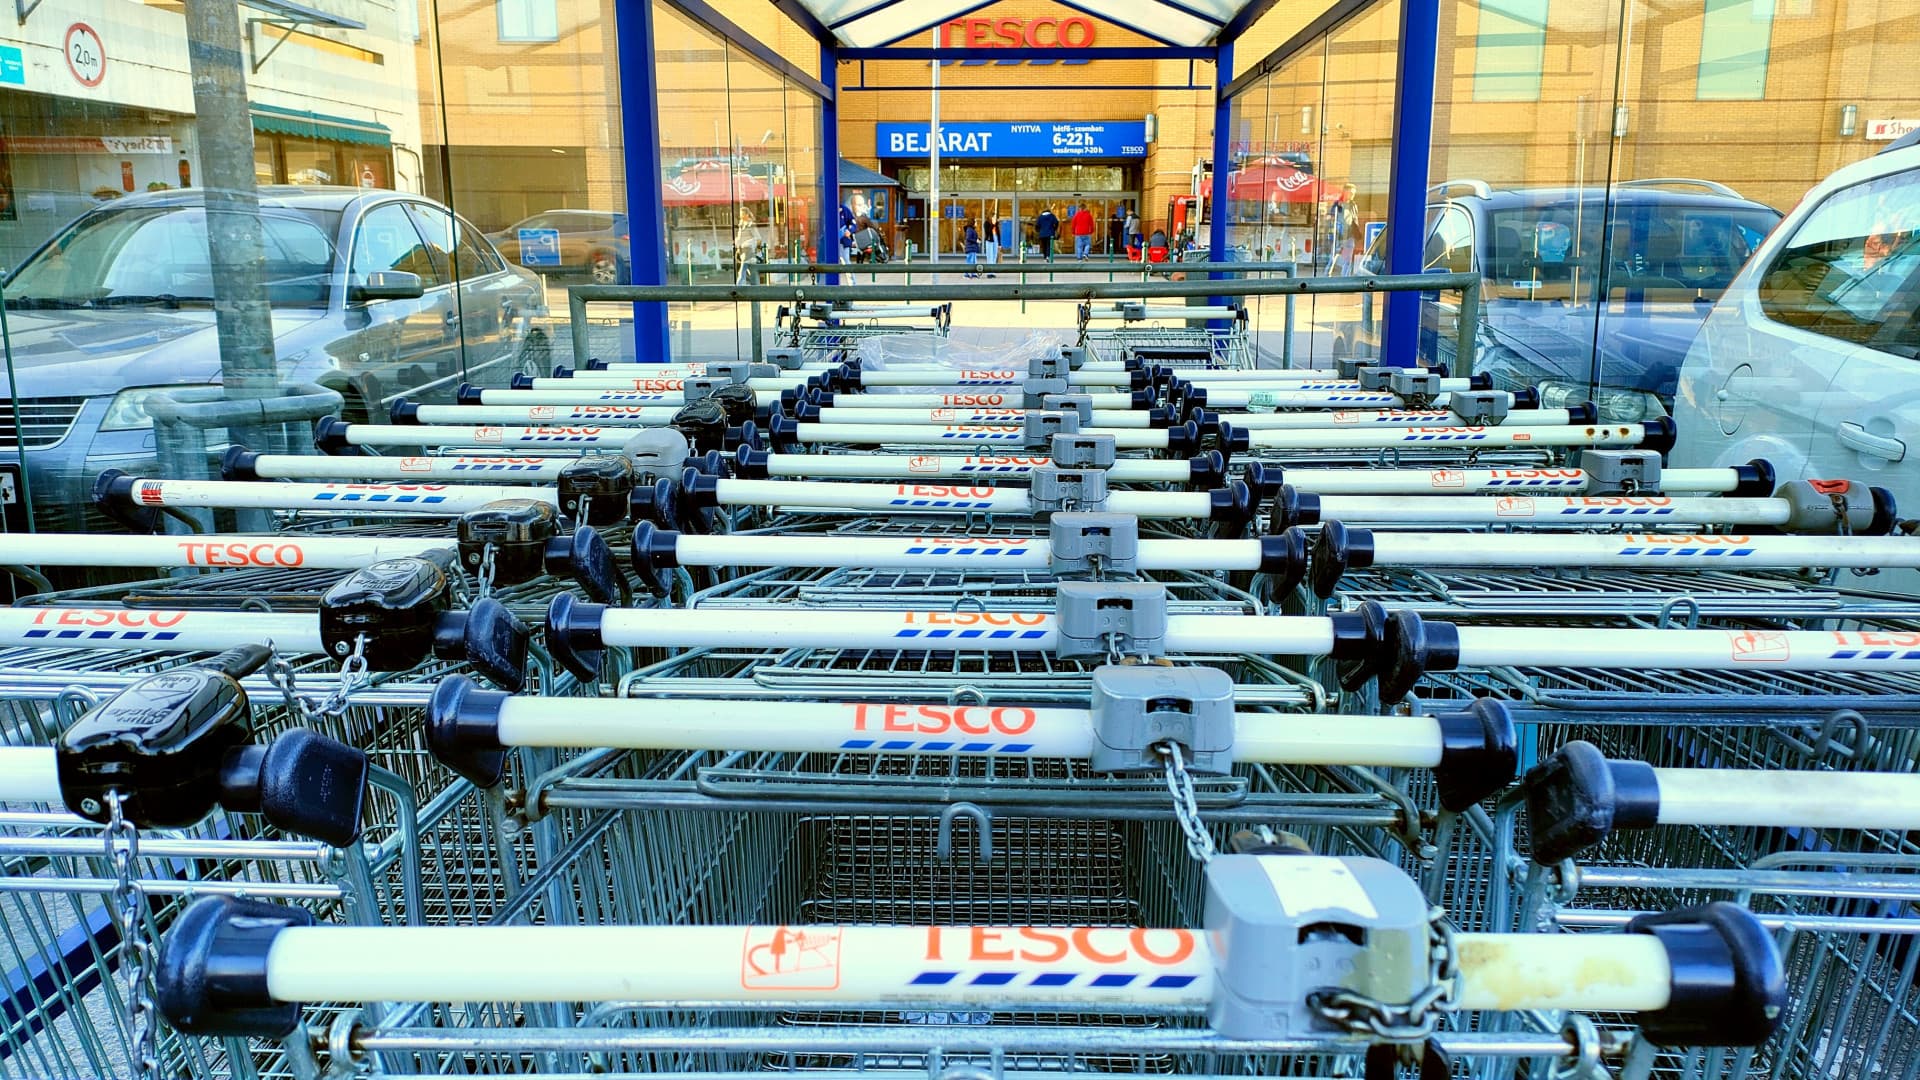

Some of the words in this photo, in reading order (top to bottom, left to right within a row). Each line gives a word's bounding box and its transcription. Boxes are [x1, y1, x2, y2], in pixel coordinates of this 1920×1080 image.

[939, 17, 1095, 48] TESCO
[890, 127, 993, 152] BEJÁRAT
[1011, 125, 1042, 133] NYITVA
[1084, 133, 1094, 145] h
[943, 395, 1003, 405] TESCO
[178, 543, 304, 567] TESCO
[843, 704, 1036, 735] TESCO
[924, 927, 1195, 965] TESCO
